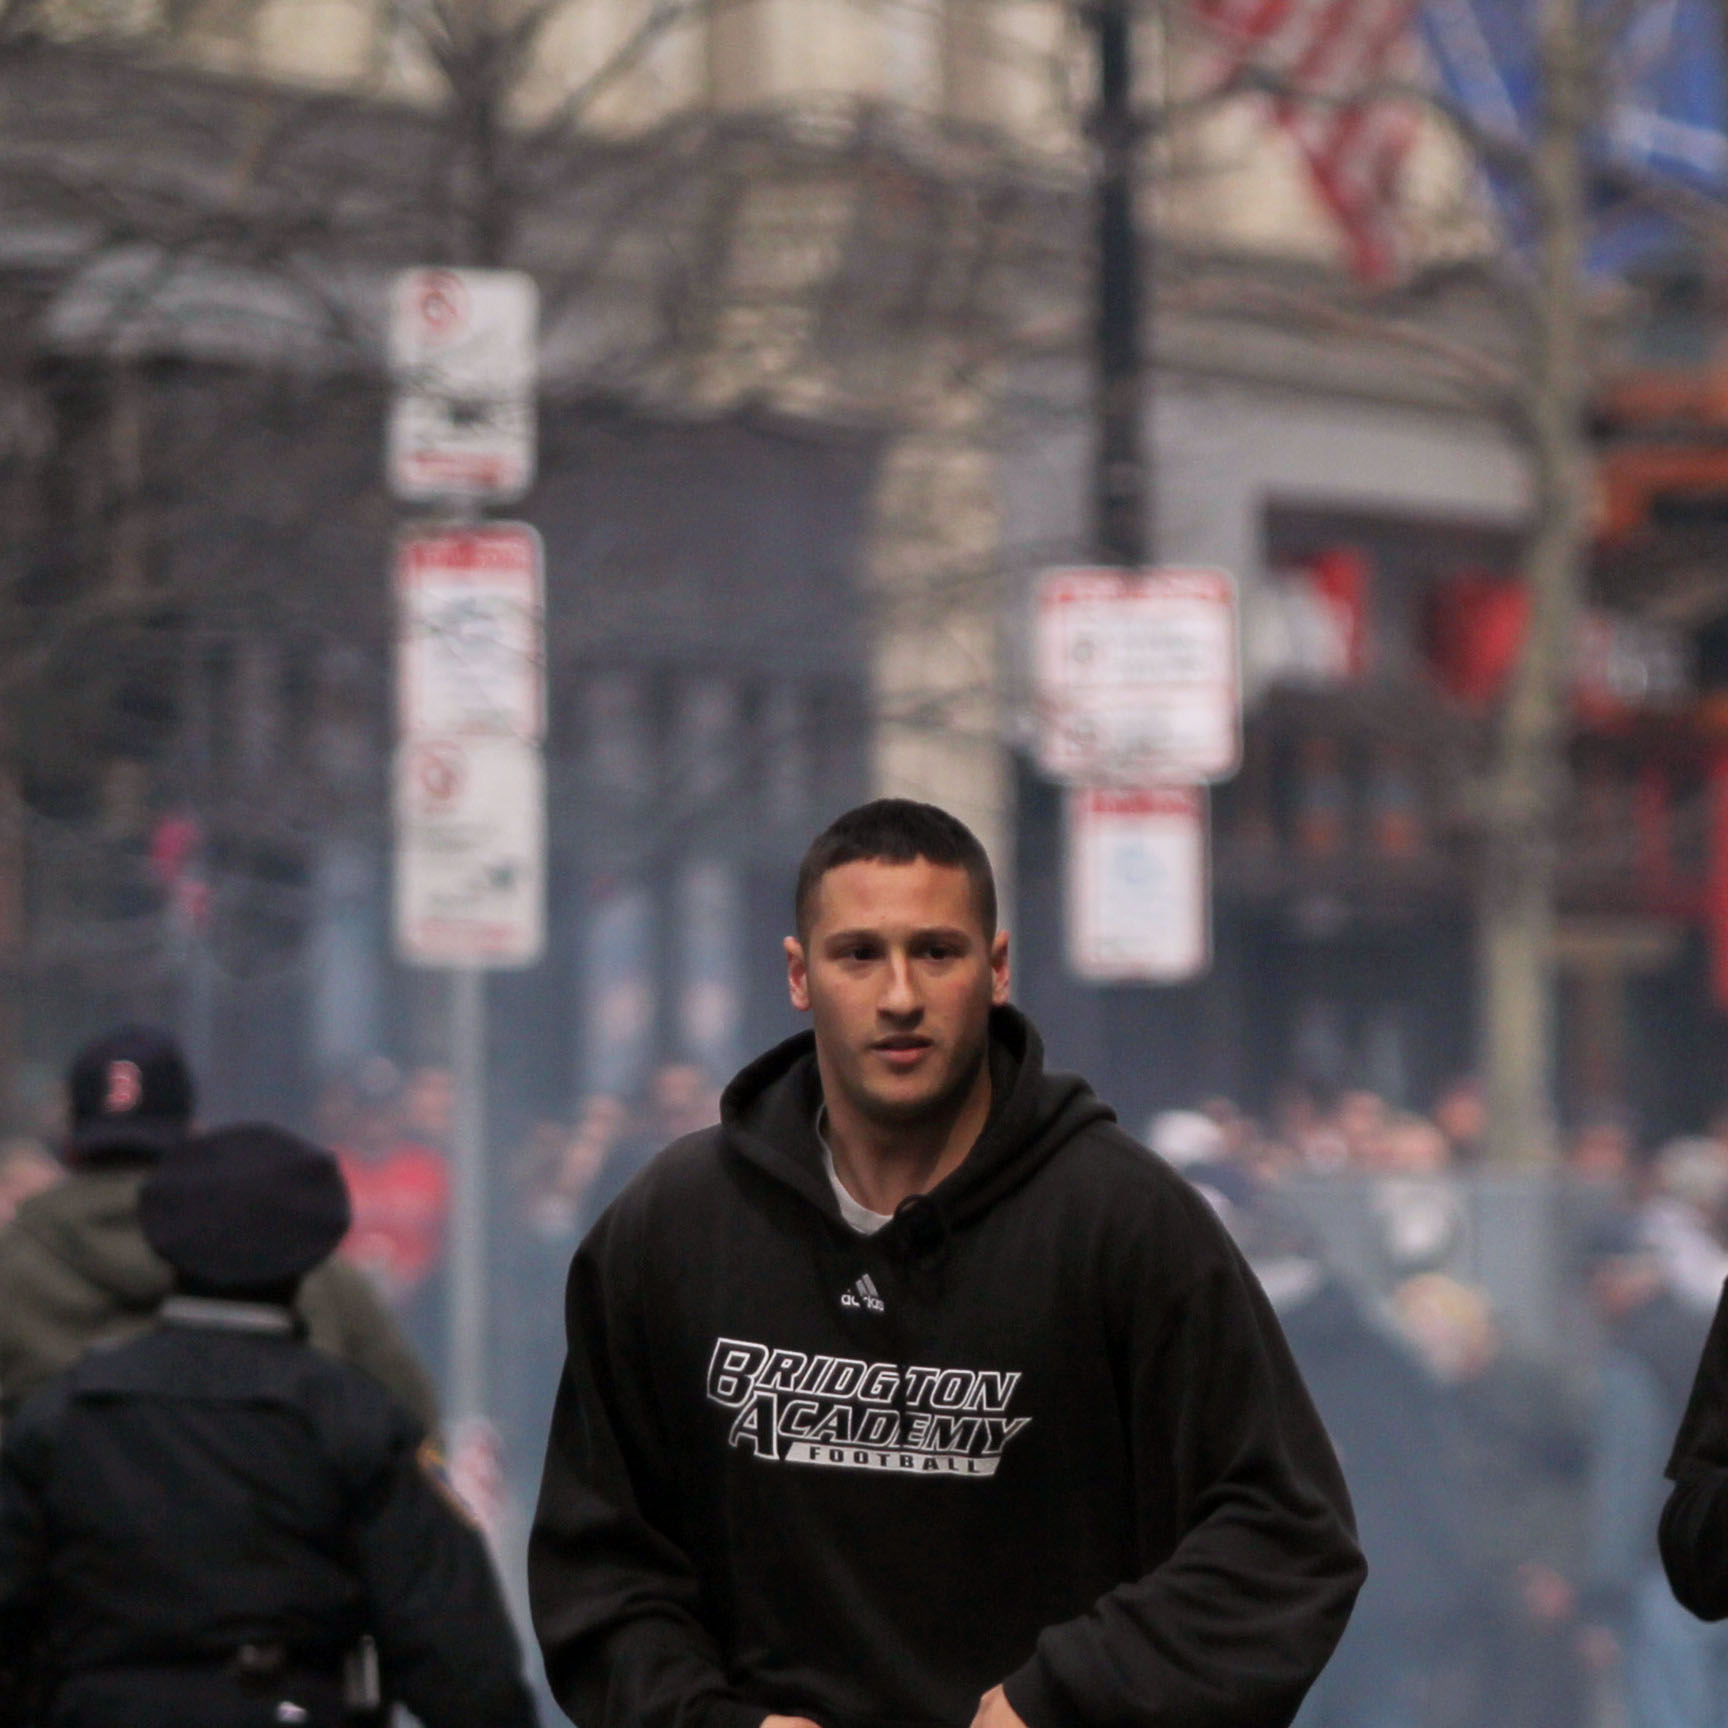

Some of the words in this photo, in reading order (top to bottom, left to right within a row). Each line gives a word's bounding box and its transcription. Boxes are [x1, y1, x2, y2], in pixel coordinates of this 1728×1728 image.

[841, 1289, 885, 1311] addas
[707, 1337, 1022, 1412] BRIDGTON
[728, 1390, 1032, 1461] ACADEMY
[809, 1447, 982, 1474] FOOTBALL
